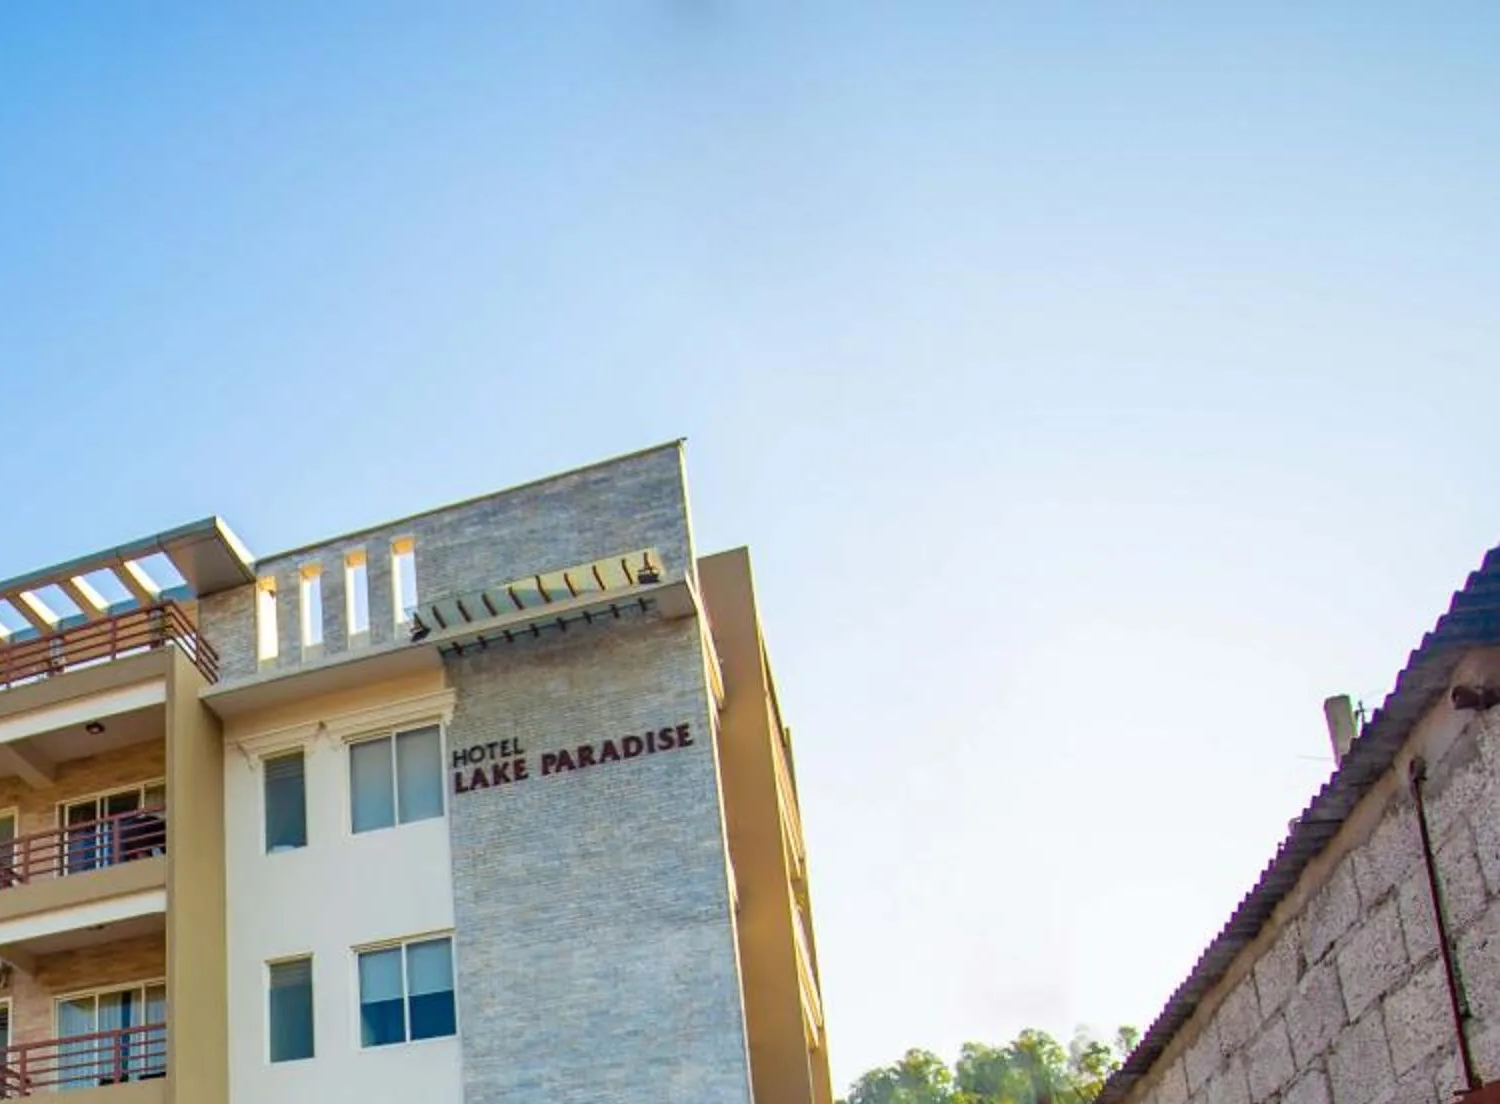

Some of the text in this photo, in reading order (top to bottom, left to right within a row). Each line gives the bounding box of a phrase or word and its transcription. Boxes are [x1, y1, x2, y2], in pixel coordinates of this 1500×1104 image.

[453, 737, 525, 768] HOTEL
[454, 723, 694, 794] LAKE PARADISE
